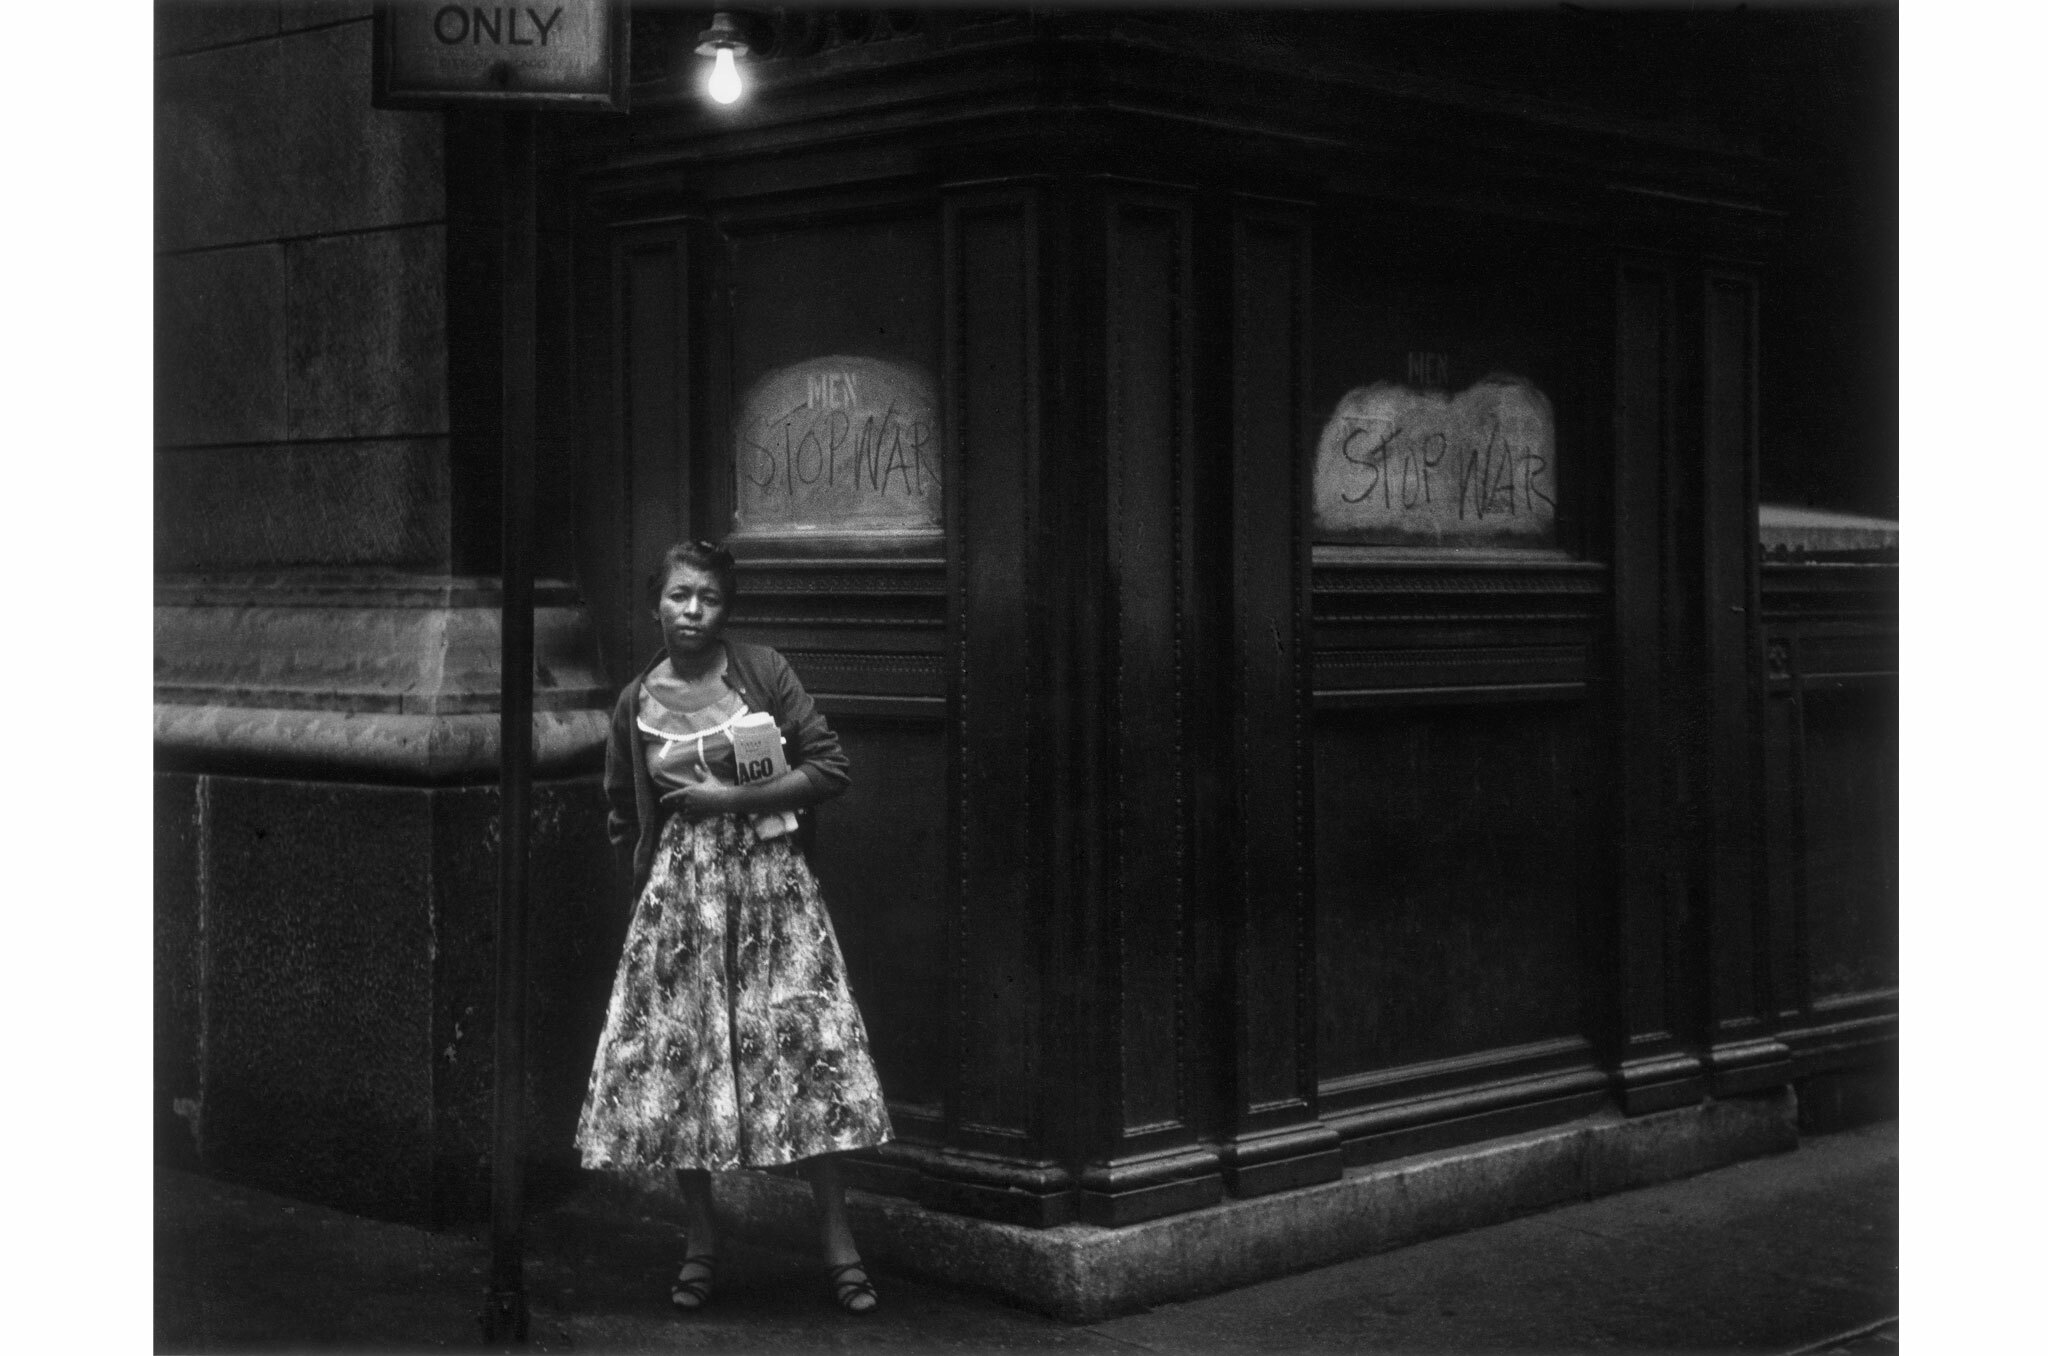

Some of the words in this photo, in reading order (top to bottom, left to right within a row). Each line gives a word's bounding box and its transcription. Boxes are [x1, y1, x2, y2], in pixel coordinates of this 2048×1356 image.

[434, 5, 563, 46] ONLY
[807, 373, 857, 408] MEN
[744, 403, 850, 496] STOP
[854, 400, 942, 497] WAR
[1341, 428, 1447, 510] STOP
[1459, 423, 1556, 520] WAR
